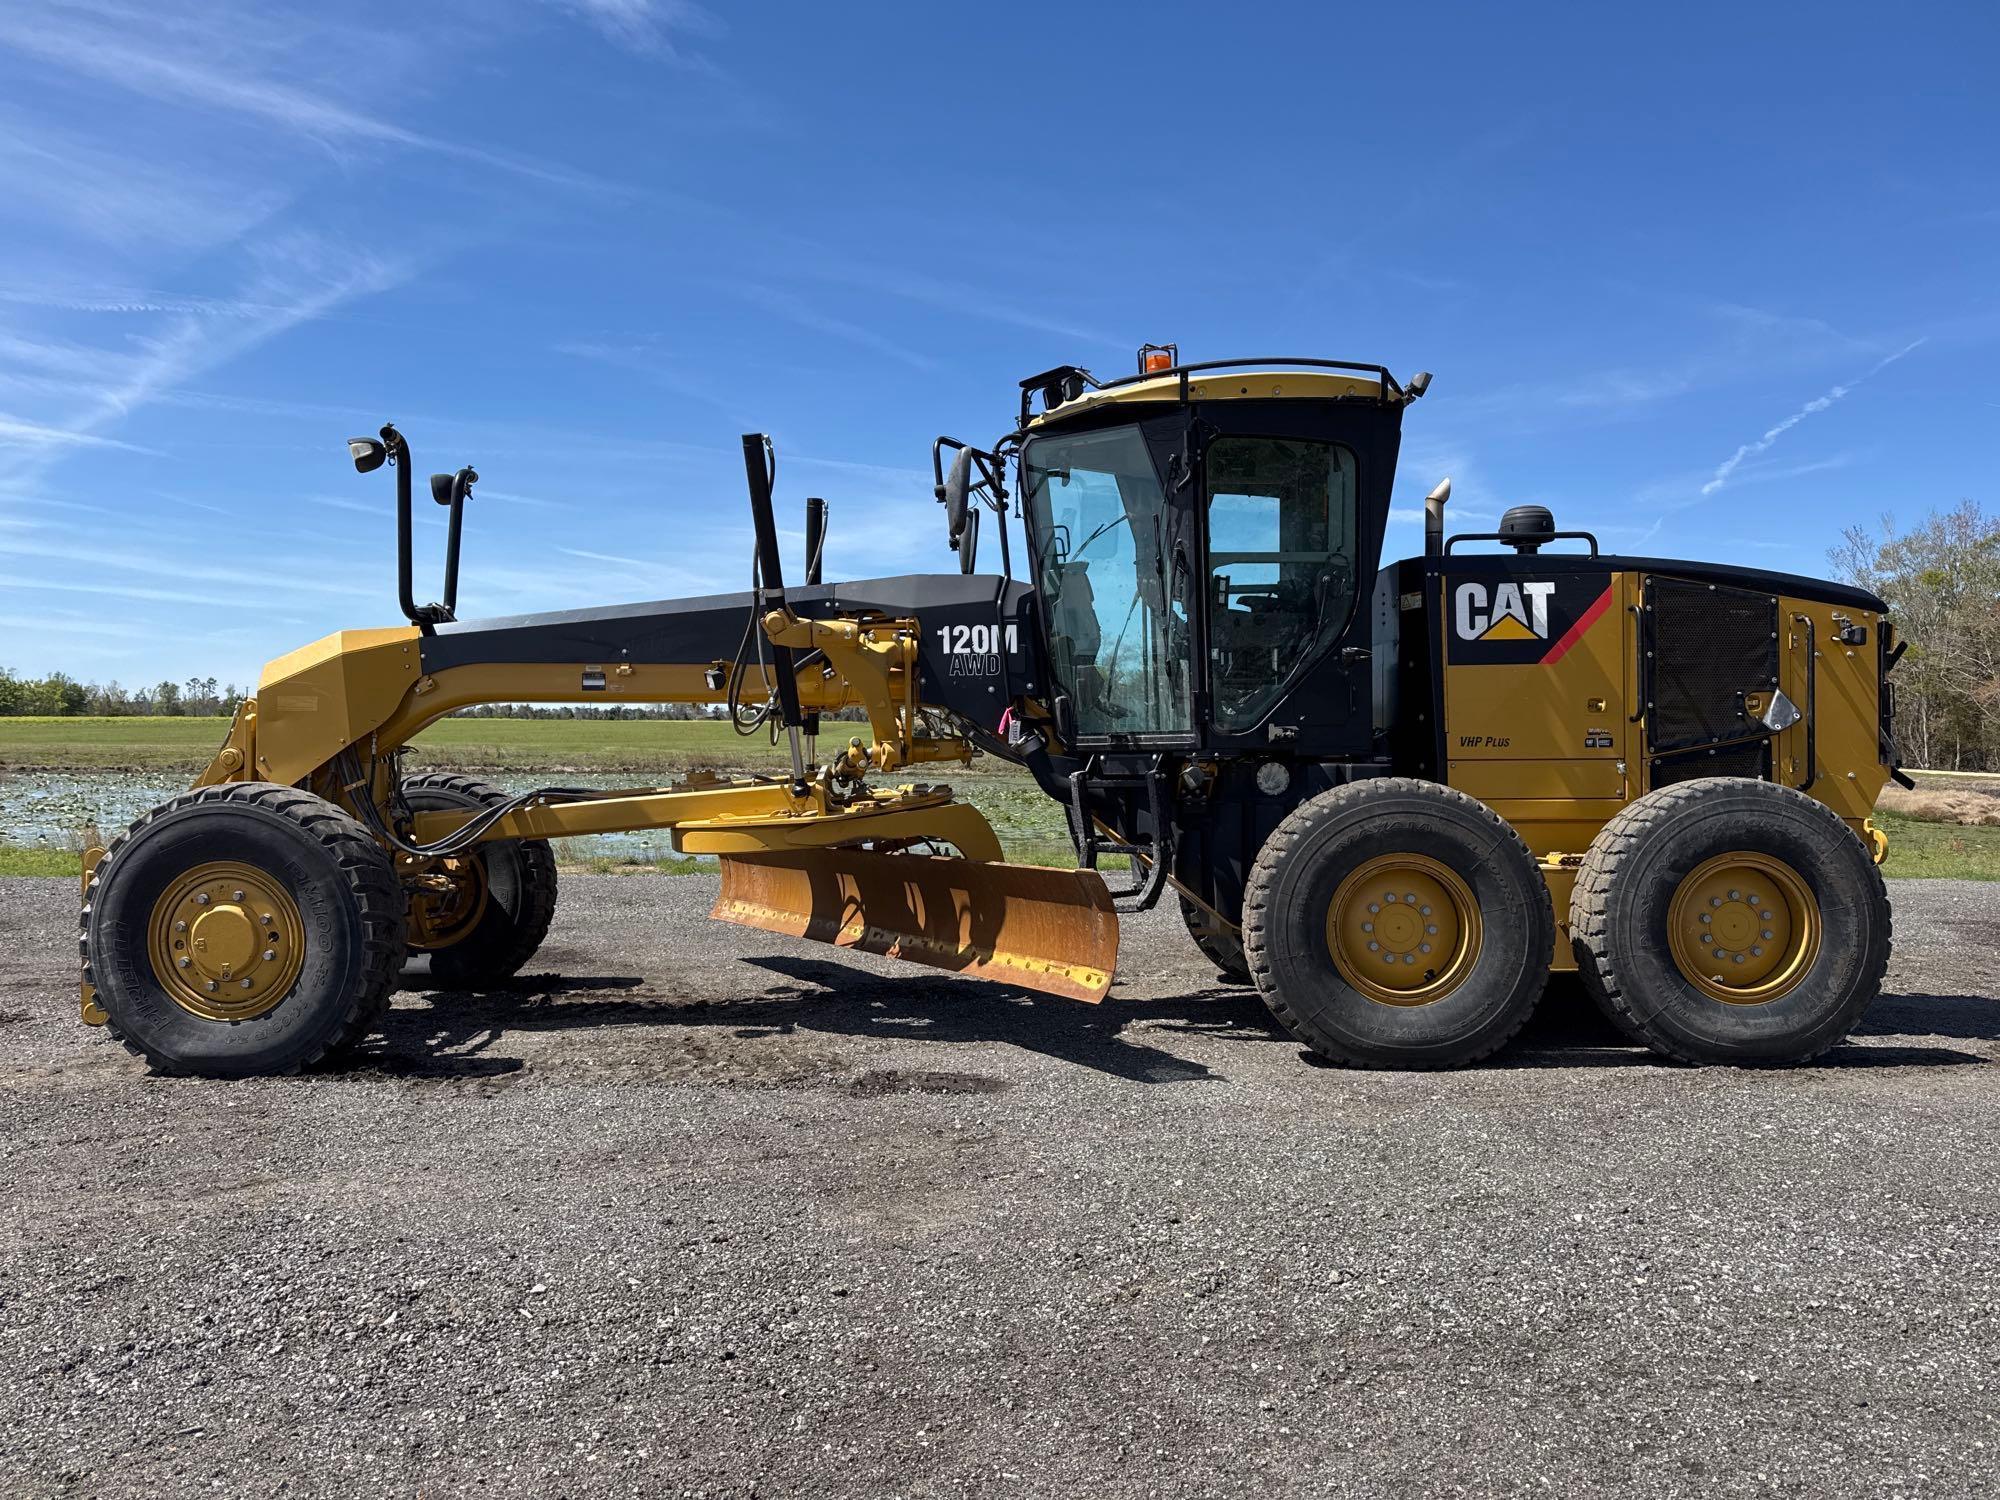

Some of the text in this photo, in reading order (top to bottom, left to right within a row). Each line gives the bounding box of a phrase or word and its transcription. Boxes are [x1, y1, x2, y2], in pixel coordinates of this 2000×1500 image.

[1455, 582, 1555, 640] CAT
[937, 624, 1018, 654] 120M
[949, 654, 1001, 676] AWD
[1460, 736, 1483, 747] VHP
